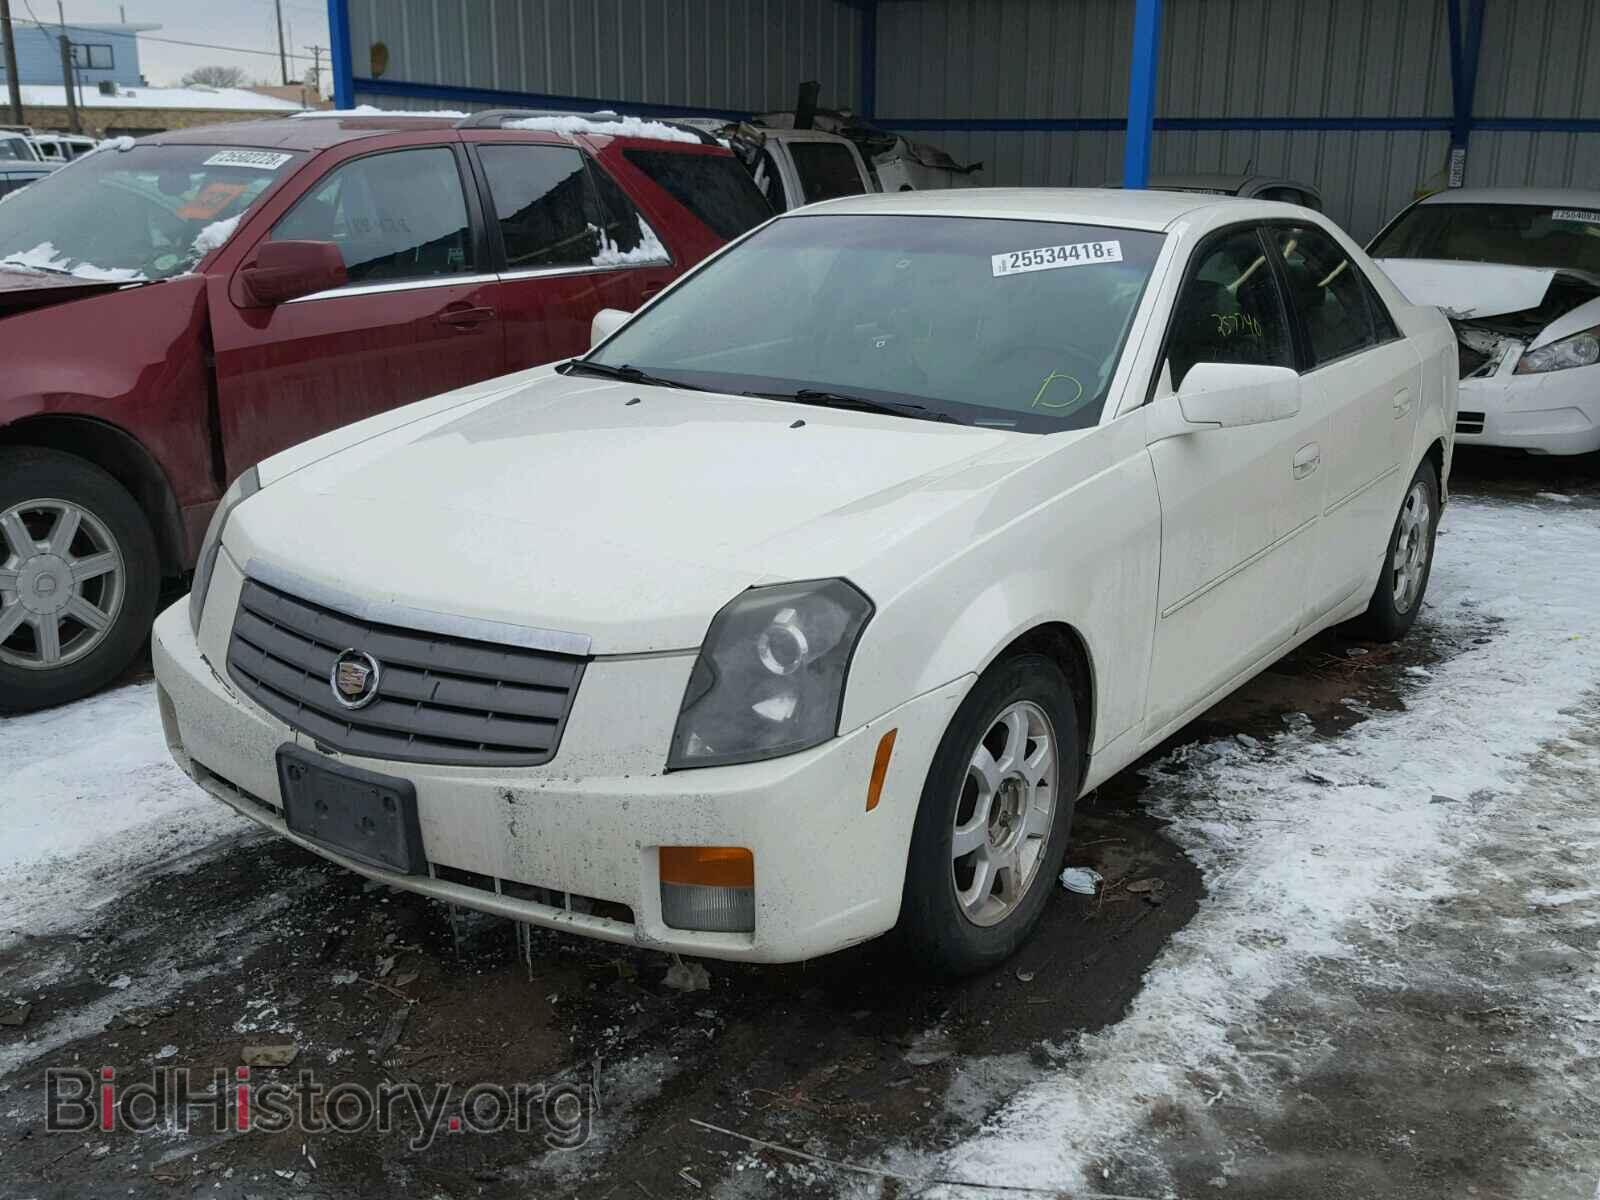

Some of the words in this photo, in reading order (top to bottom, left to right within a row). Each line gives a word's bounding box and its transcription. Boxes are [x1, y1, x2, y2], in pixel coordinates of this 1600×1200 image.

[1009, 242, 1105, 269] 25534418
[1107, 247, 1115, 257] E
[1031, 369, 1083, 408] D
